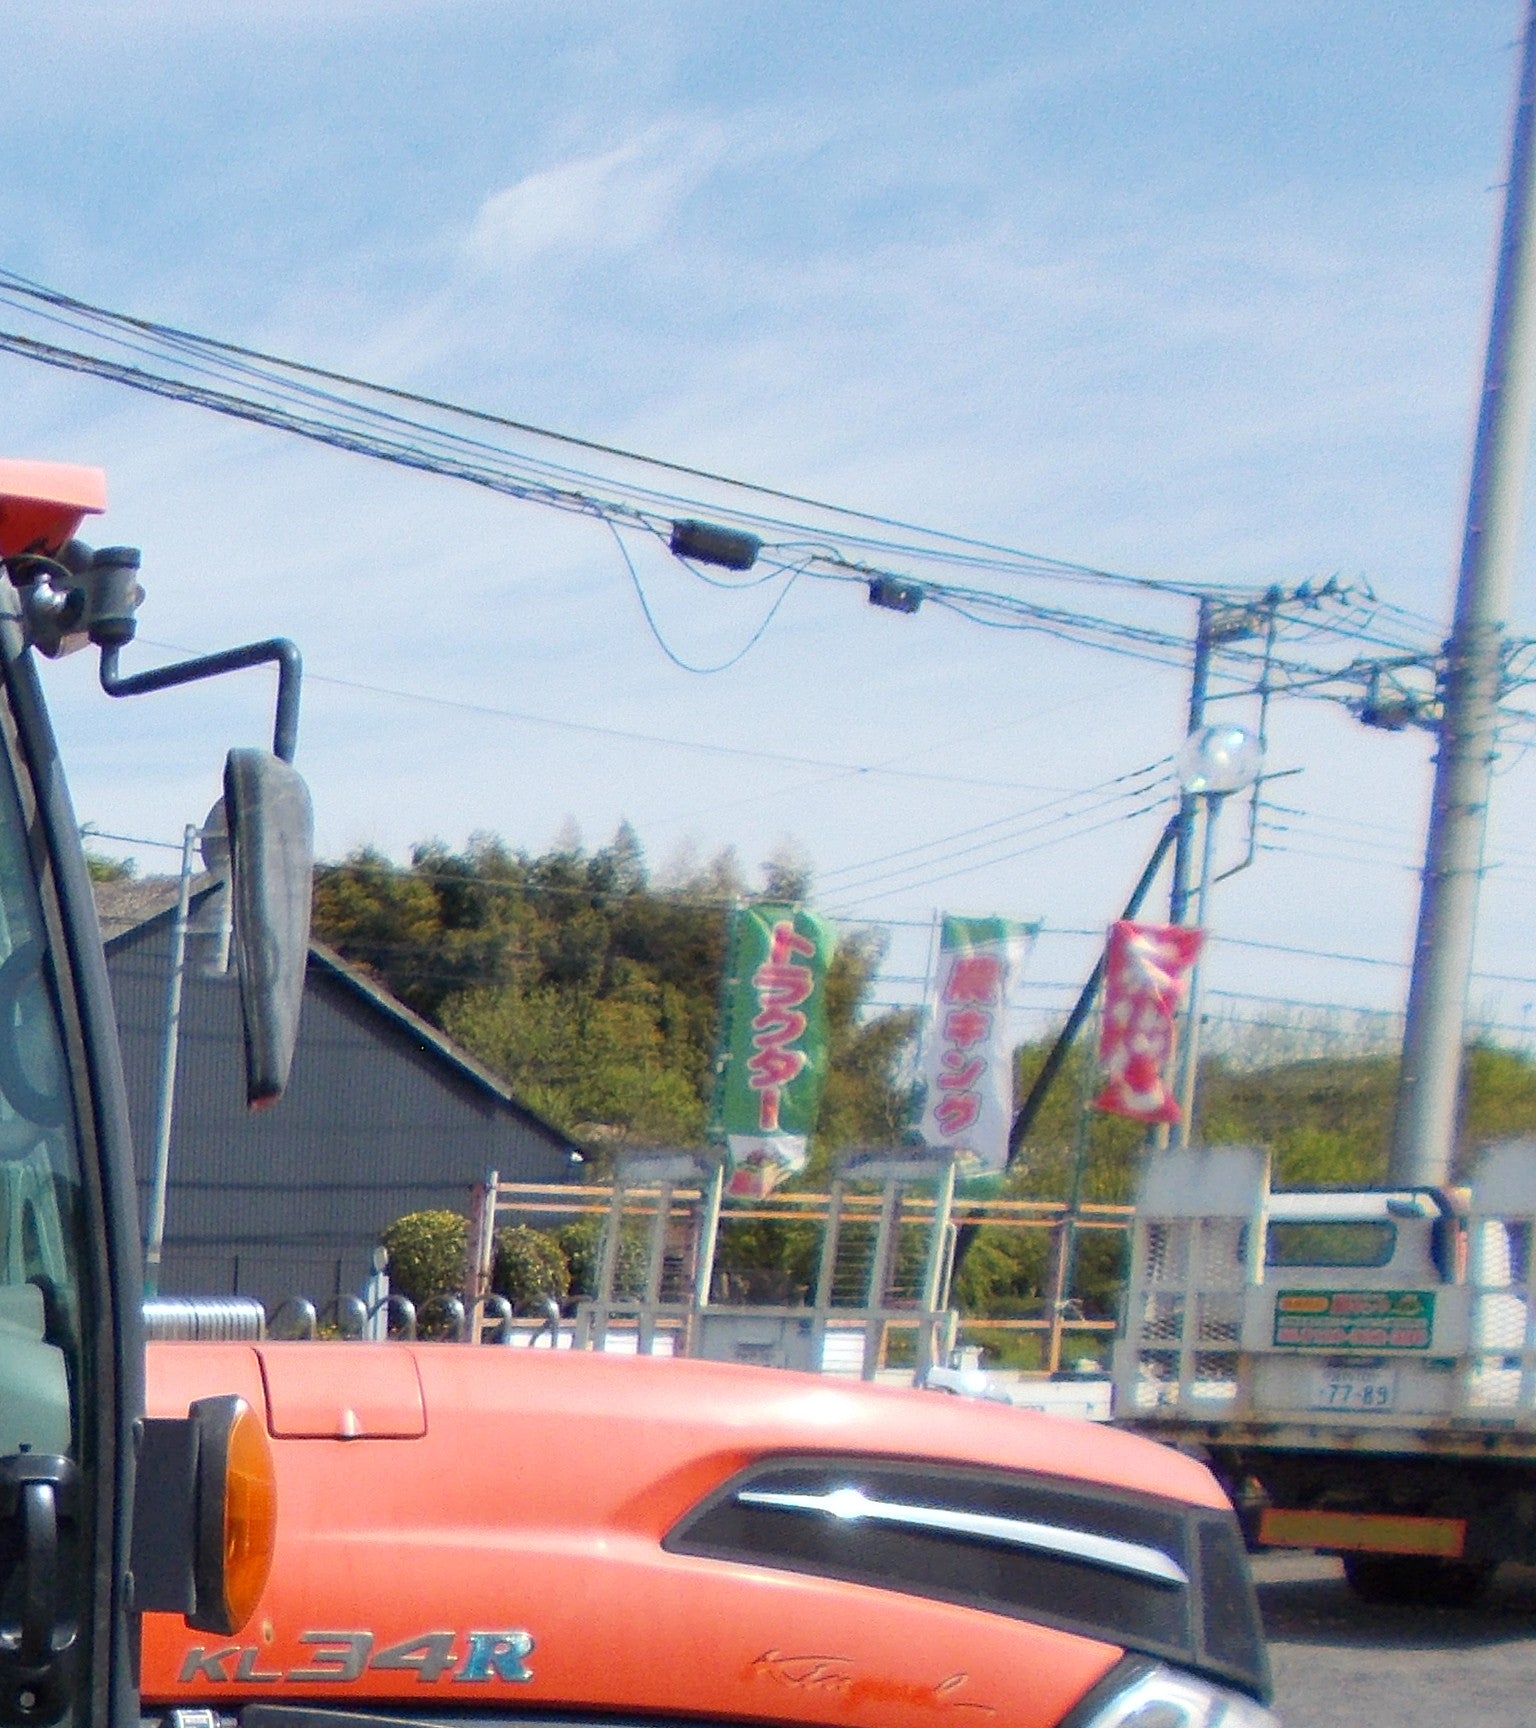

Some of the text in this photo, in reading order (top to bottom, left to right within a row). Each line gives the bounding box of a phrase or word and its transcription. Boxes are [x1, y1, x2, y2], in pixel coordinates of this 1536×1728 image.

[747, 920, 817, 1133] トラクター
[177, 1629, 535, 1684] KL34R
